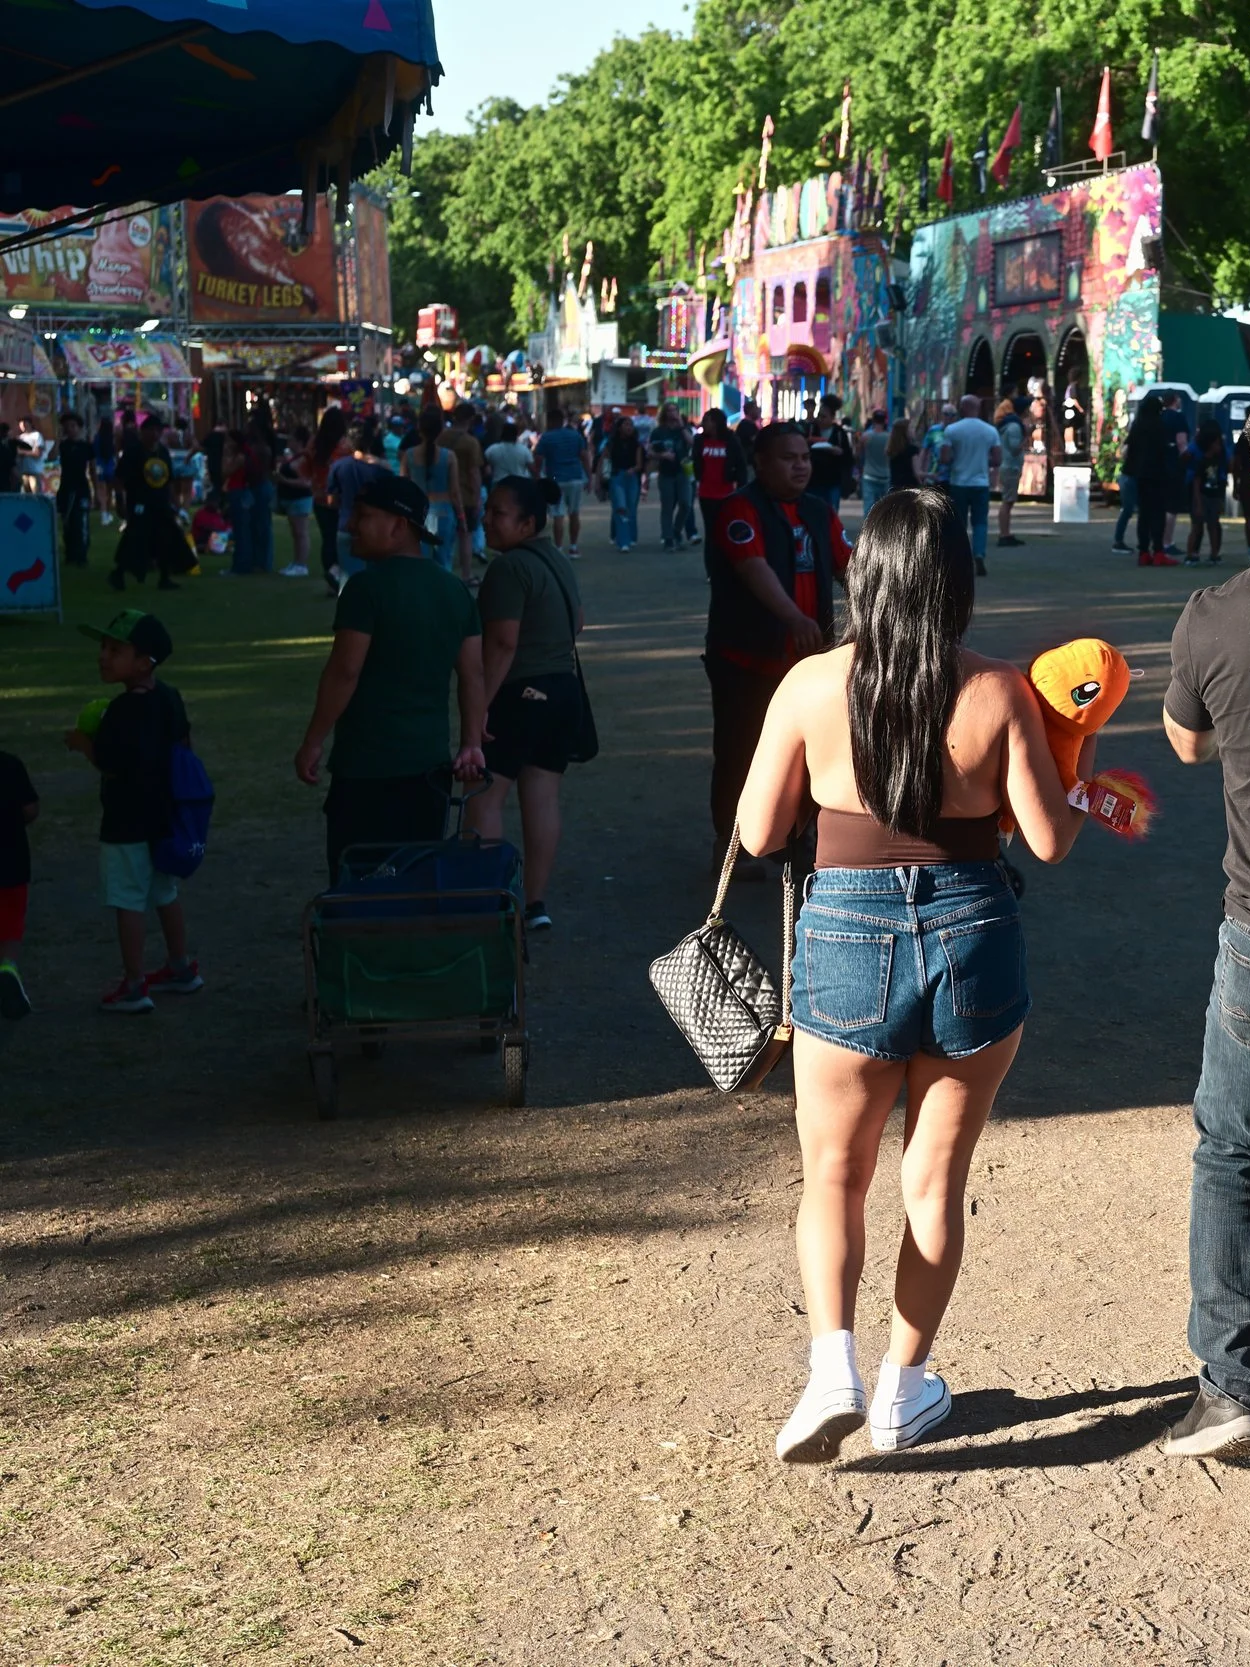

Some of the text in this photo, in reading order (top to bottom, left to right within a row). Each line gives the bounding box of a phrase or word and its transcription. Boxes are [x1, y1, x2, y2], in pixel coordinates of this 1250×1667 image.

[2, 240, 87, 281] Whip
[97, 256, 132, 277] Mango
[87, 281, 144, 302] Strawberry
[197, 272, 305, 307] TURKEY LEGS
